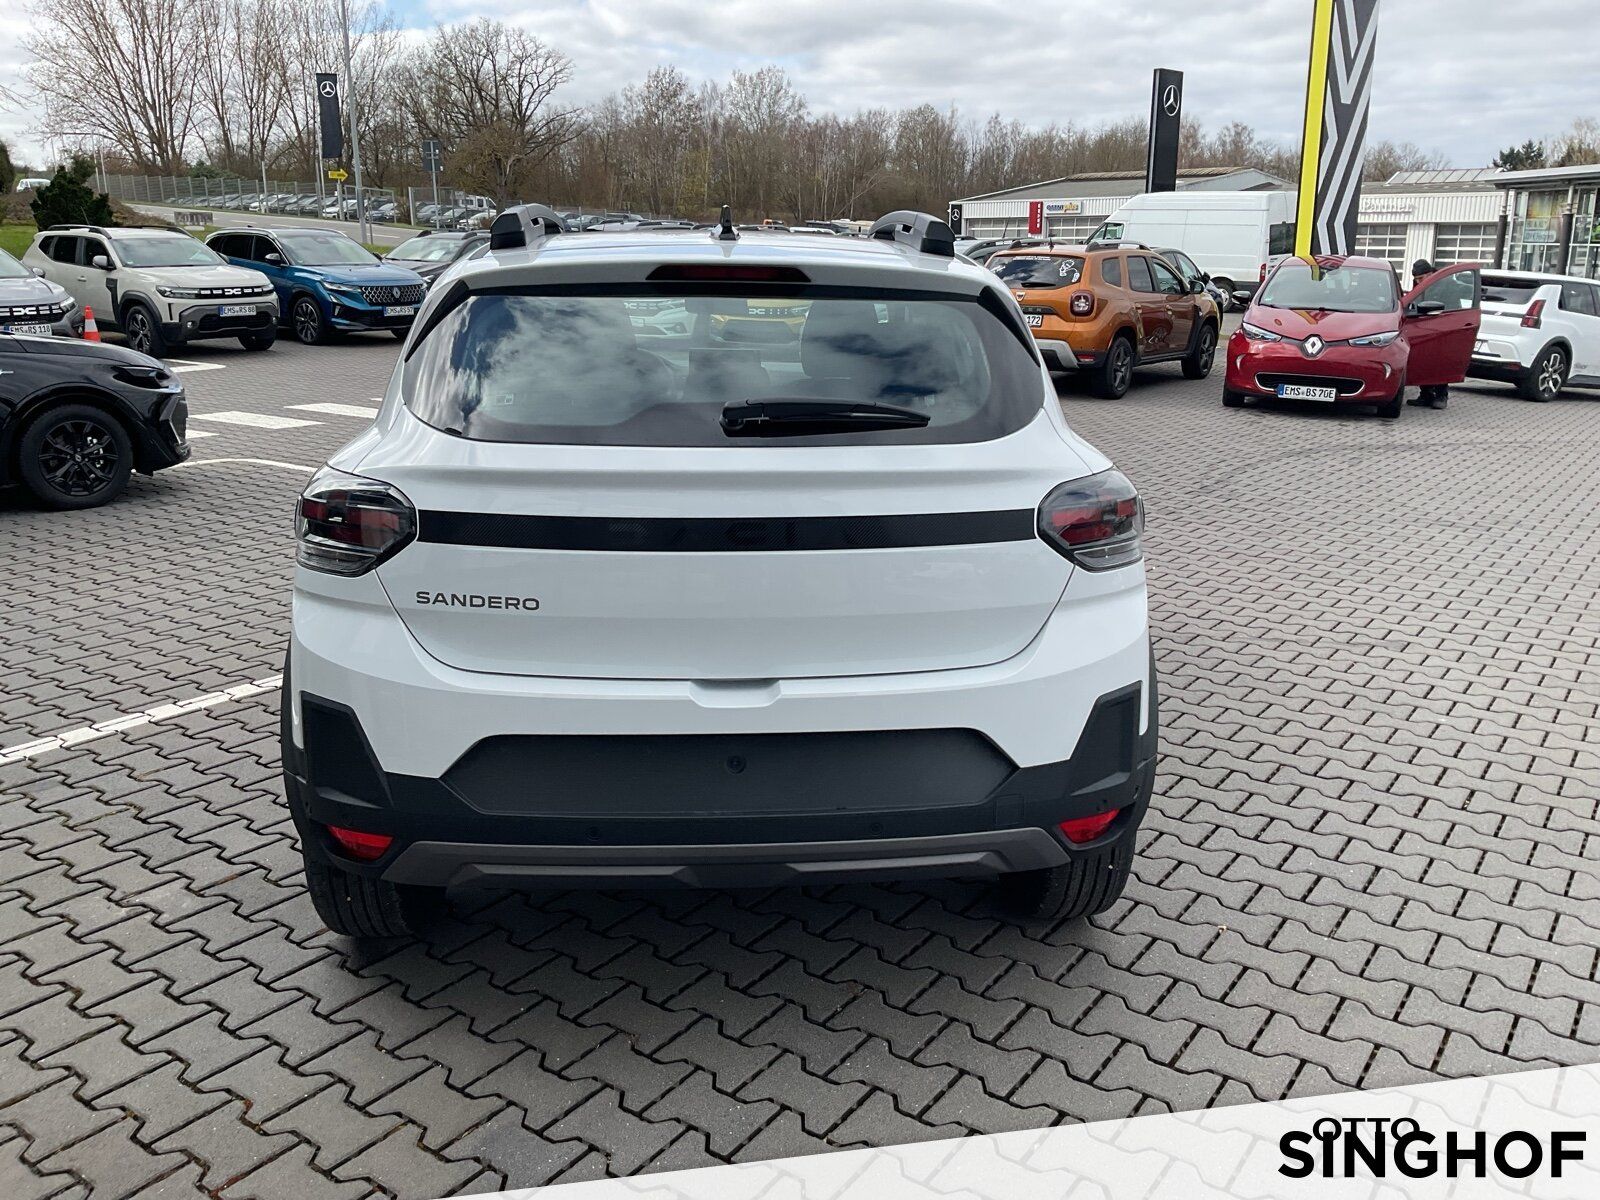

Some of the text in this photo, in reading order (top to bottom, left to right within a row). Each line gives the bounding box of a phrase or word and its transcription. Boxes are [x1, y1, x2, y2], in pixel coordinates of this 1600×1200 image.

[223, 306, 236, 315] EMS
[1026, 315, 1042, 325] 172
[10, 326, 24, 334] EMS
[1284, 386, 1335, 399] EMS BS 70E
[416, 591, 540, 611] SANDERO
